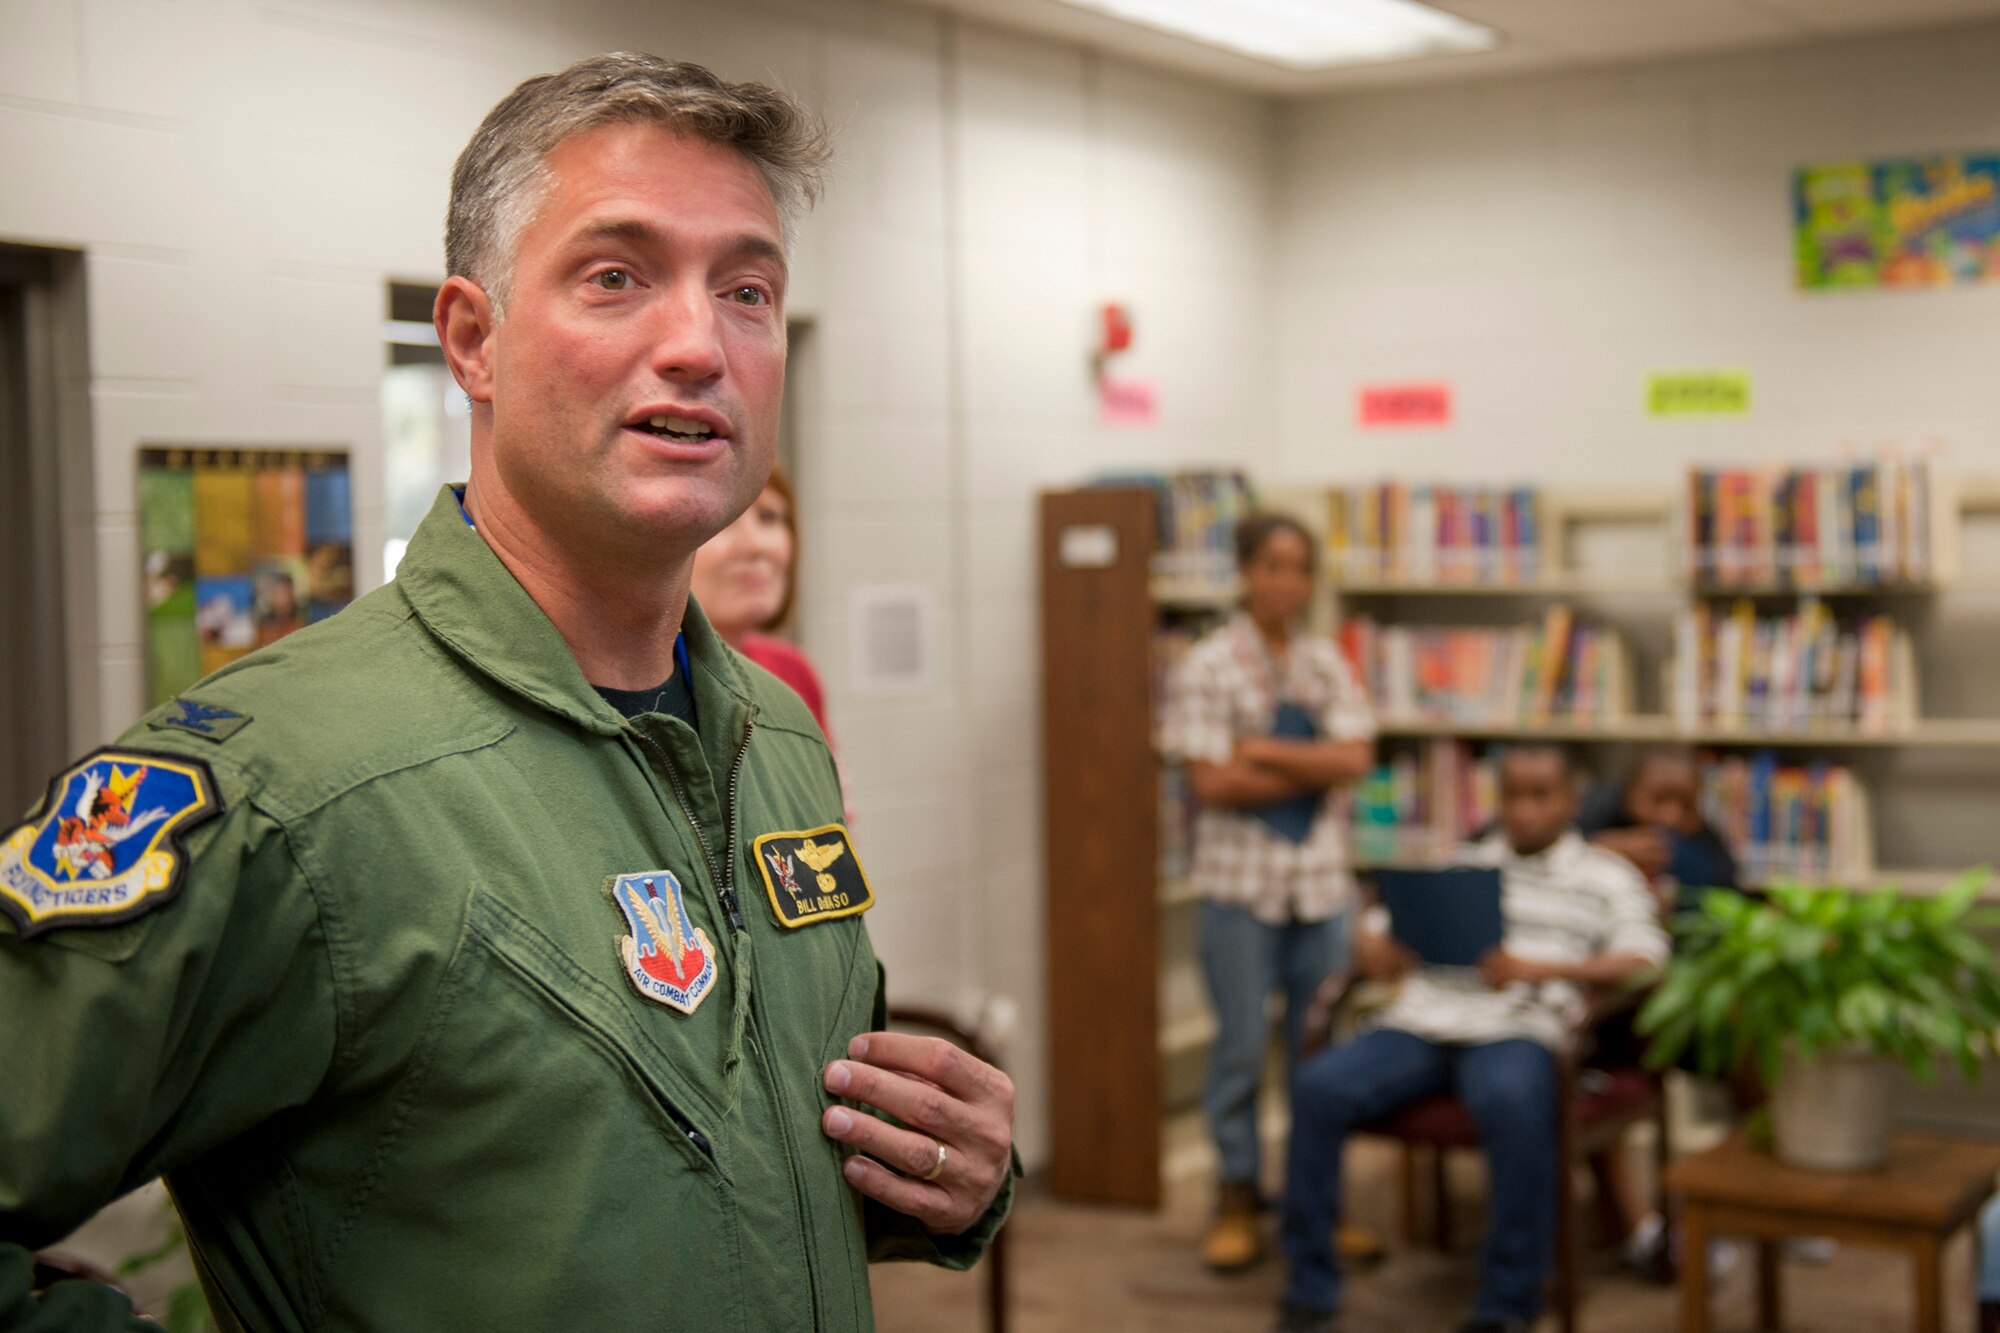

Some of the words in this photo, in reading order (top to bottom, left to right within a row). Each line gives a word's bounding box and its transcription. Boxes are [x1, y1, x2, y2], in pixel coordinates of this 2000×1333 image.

[53, 883, 128, 906] TIGERS
[795, 897, 818, 915] BILL
[634, 968, 650, 988] AIR
[652, 981, 691, 1007] COMBAT
